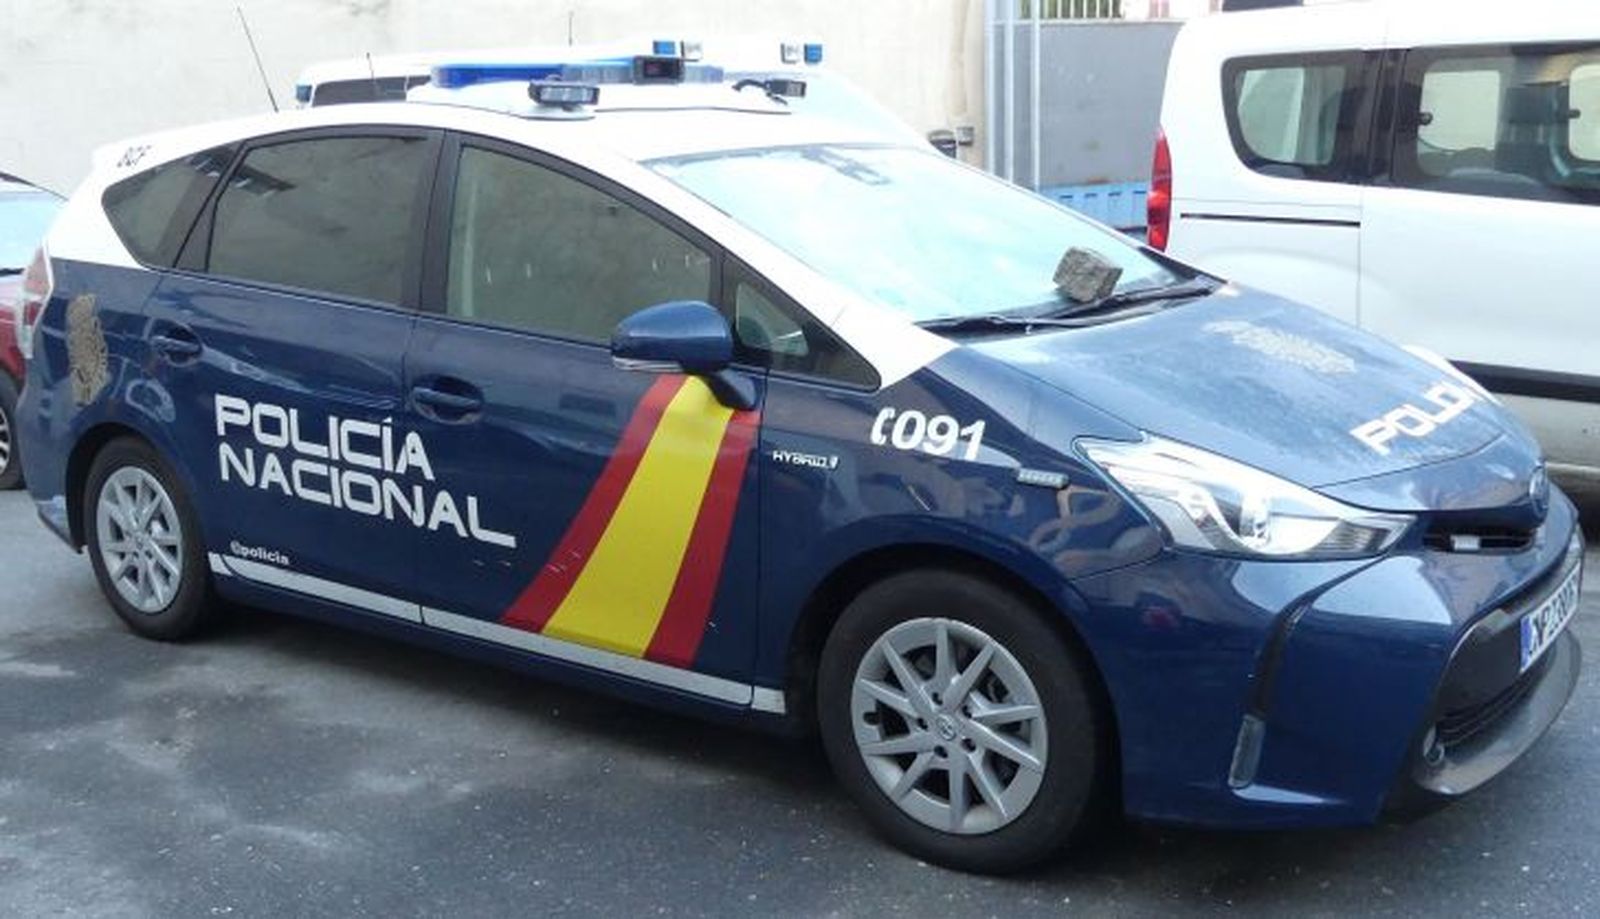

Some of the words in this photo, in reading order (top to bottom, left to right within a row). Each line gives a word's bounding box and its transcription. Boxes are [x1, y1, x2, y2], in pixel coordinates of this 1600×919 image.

[214, 394, 436, 481] POLICÍA
[892, 409, 986, 461] 091
[218, 441, 517, 549] NACIONAL
